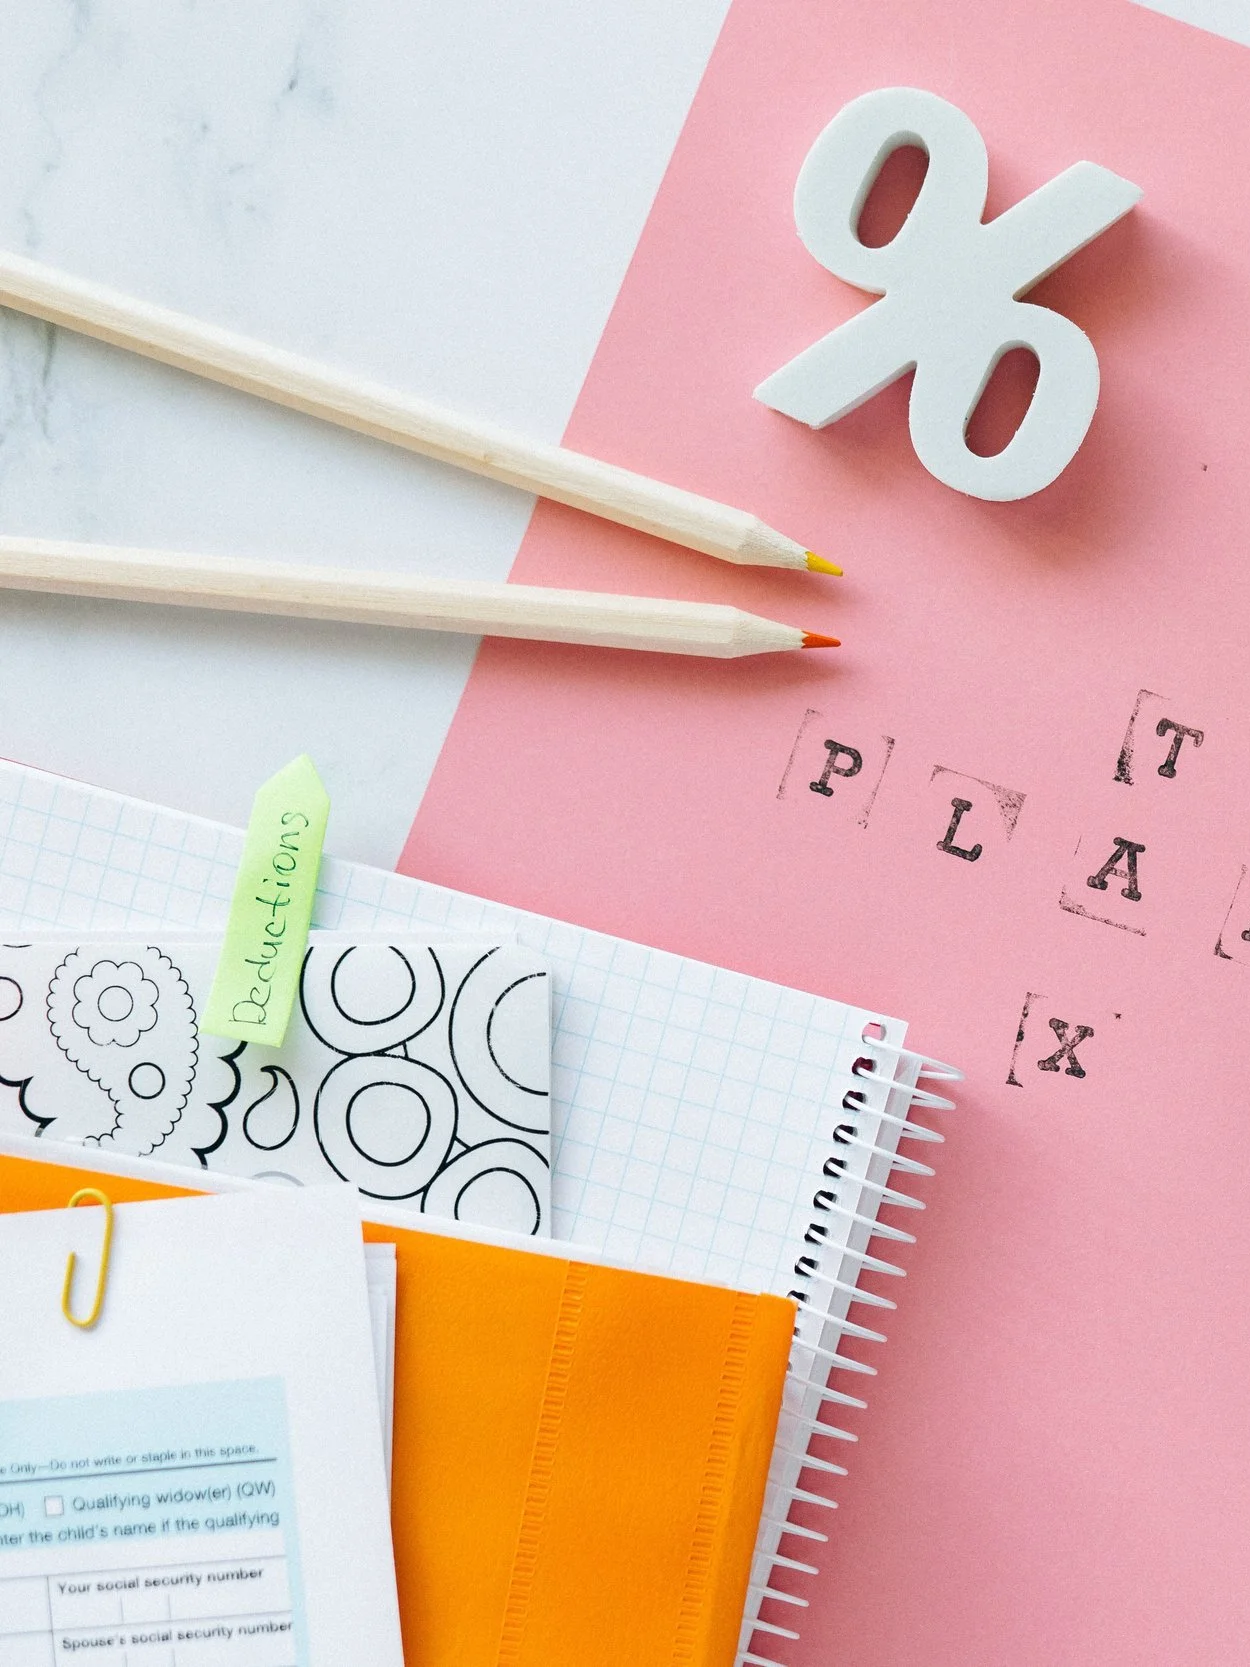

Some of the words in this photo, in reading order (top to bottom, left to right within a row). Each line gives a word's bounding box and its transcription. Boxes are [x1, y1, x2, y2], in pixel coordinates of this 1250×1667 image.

[228, 811, 309, 1026] Deductions
[71, 1457, 91, 1470] not
[94, 1454, 122, 1467] write
[126, 1454, 138, 1464] or
[142, 1448, 177, 1464] staple
[181, 1447, 192, 1460] in
[195, 1445, 217, 1458] this
[220, 1443, 260, 1458] space.
[72, 1492, 151, 1513] Qualifying
[156, 1482, 232, 1503] widow(er)
[236, 1479, 276, 1499] (QW)
[28, 1529, 54, 1544] the
[58, 1523, 108, 1542] child's
[113, 1522, 157, 1536] name
[161, 1516, 172, 1532] if
[174, 1515, 200, 1531] the
[204, 1510, 280, 1533] qualifying
[58, 1582, 92, 1596] Your
[96, 1576, 140, 1593] social
[144, 1572, 202, 1590] security
[206, 1567, 265, 1584] number
[61, 1633, 127, 1653] Spouse's
[131, 1631, 173, 1645] social
[177, 1626, 234, 1642] security
[237, 1621, 294, 1637] number
